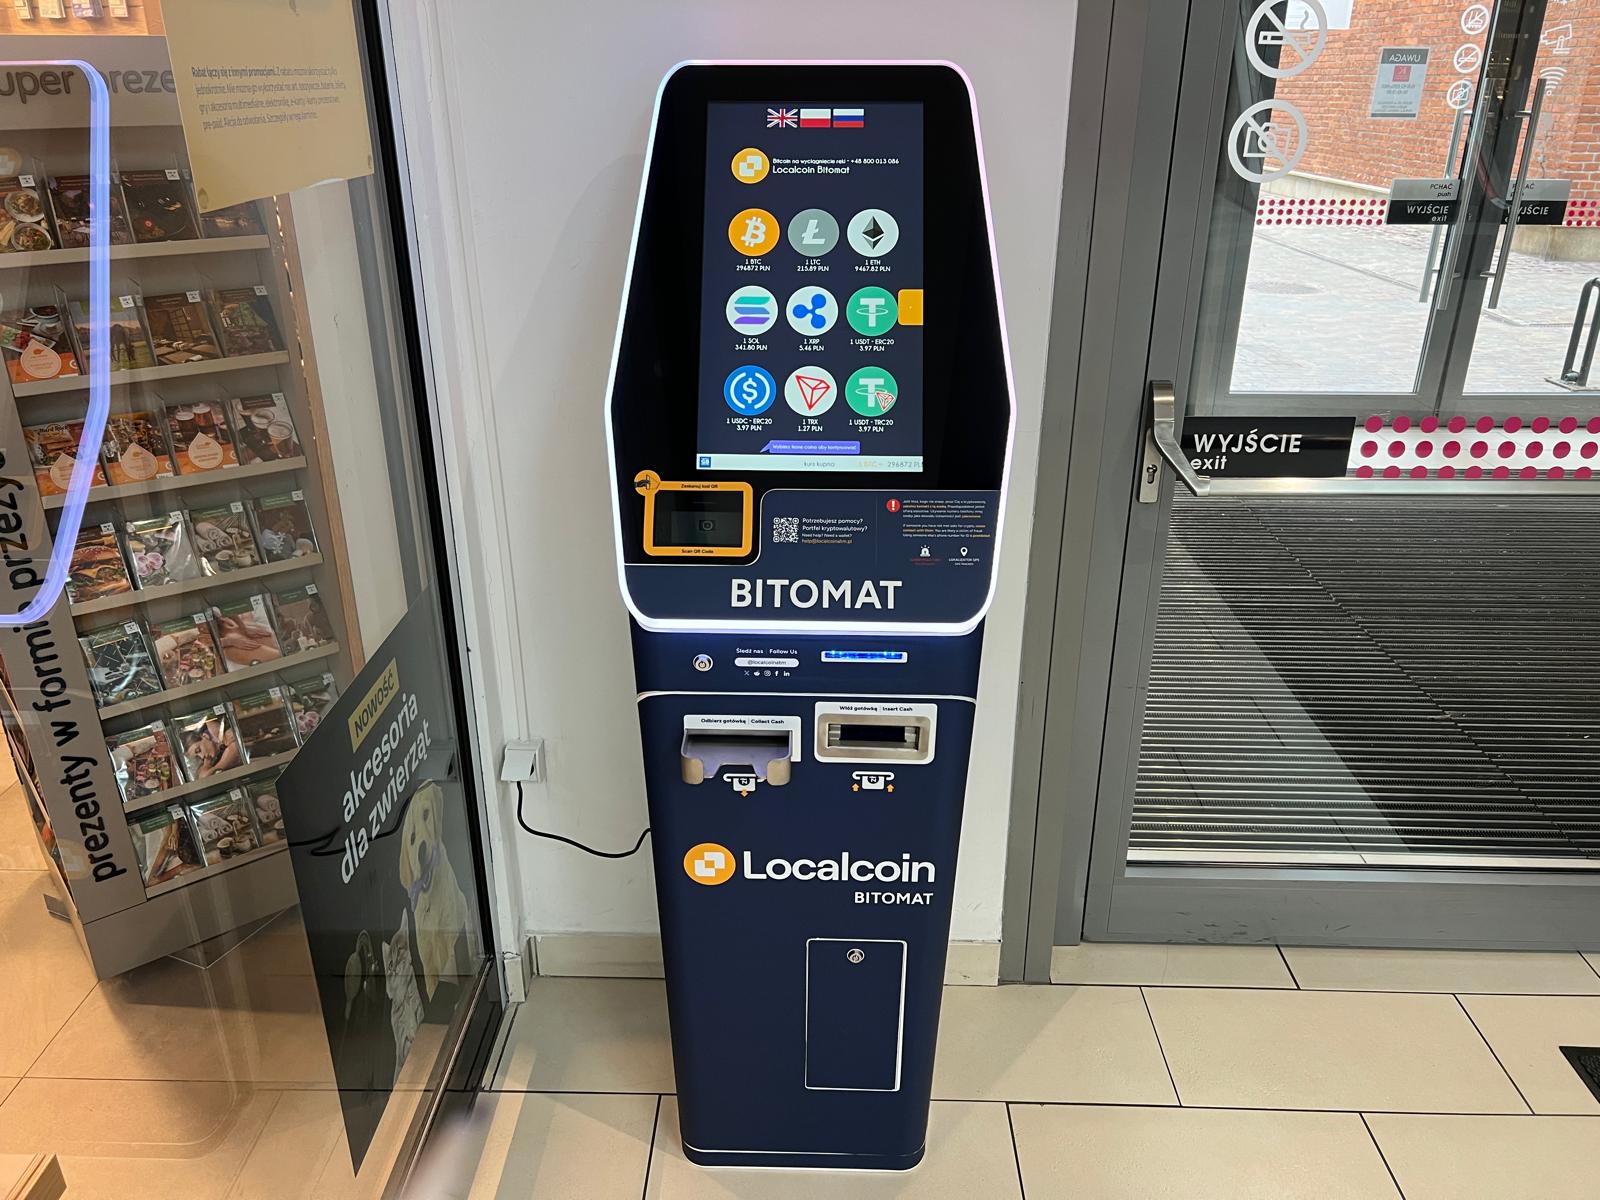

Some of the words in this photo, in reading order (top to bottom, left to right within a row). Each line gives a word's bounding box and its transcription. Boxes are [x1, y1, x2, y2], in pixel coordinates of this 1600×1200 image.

[773, 165, 815, 174] Localcoin
[817, 165, 850, 174] Bitomat
[1407, 204, 1449, 214] WYJŚCIE
[1193, 429, 1303, 453] WYJŚCIE
[1191, 456, 1228, 470] exit
[838, 518, 863, 526] pomocy?
[731, 578, 903, 609] BITOMAT
[354, 669, 395, 738] NOWOŚĆ
[50, 720, 79, 748] w
[342, 692, 418, 823] akcesoria
[341, 827, 369, 884] dla
[369, 719, 432, 841] zwierząt
[59, 754, 127, 883] prezenty
[743, 851, 936, 882] Localcoin
[855, 891, 934, 905] BITOMAT
